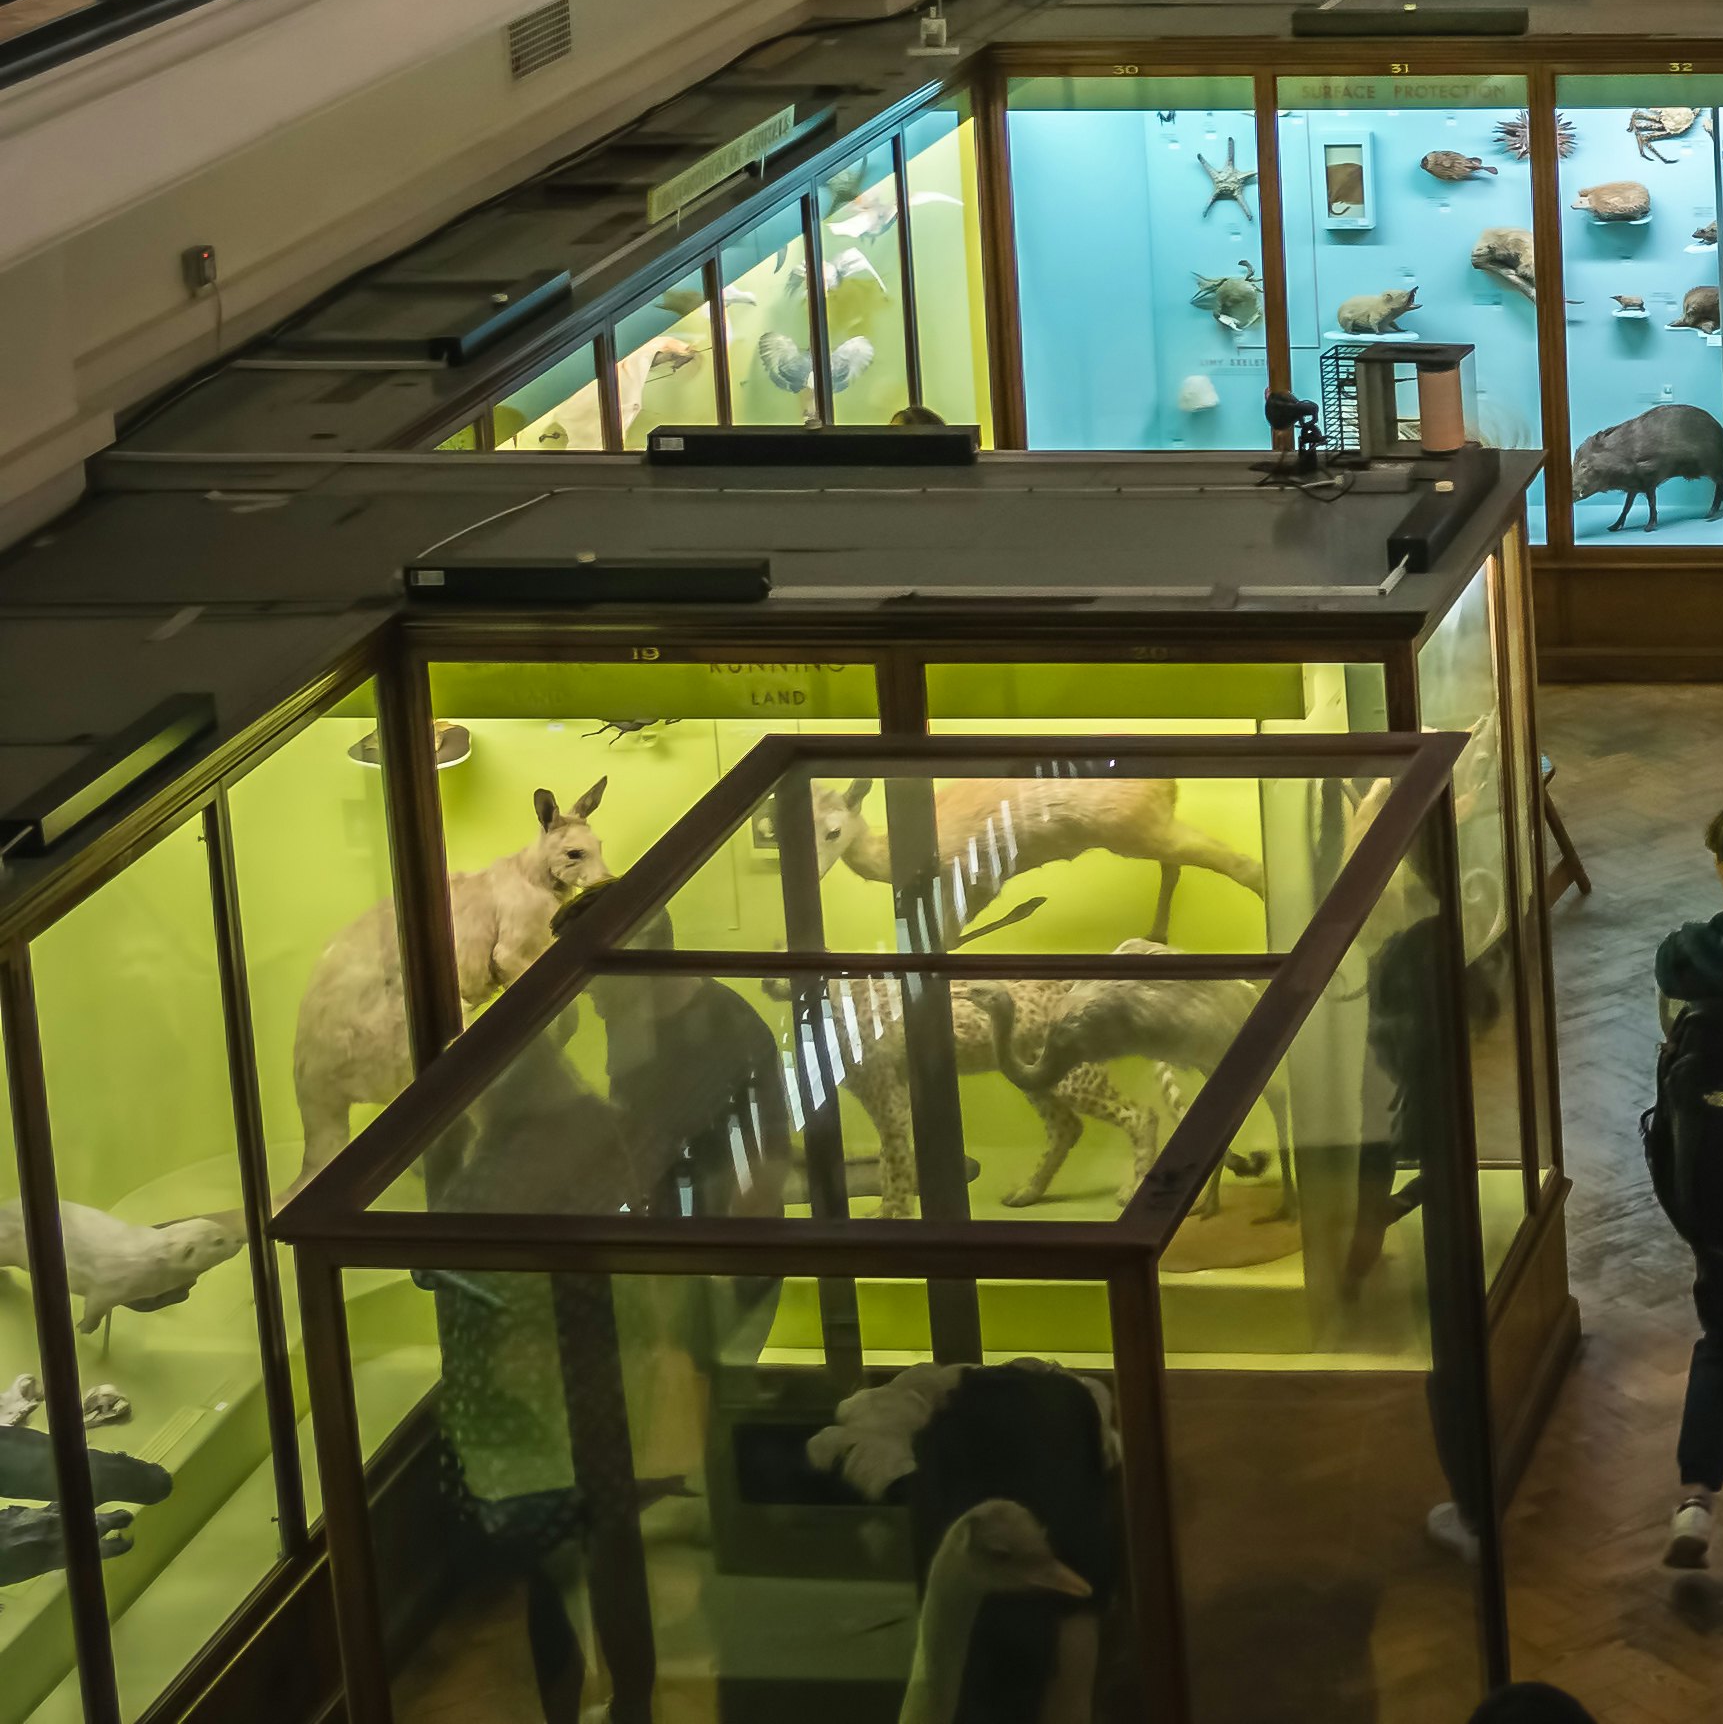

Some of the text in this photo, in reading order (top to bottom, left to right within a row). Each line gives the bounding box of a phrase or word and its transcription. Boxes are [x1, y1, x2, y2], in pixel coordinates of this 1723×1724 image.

[1112, 65, 1139, 75] 30
[1391, 63, 1409, 73] 31
[1669, 62, 1693, 72] 32
[1302, 84, 1505, 100] SURFACE PROTECTION
[632, 647, 660, 661] 19
[751, 691, 805, 705] LAND
